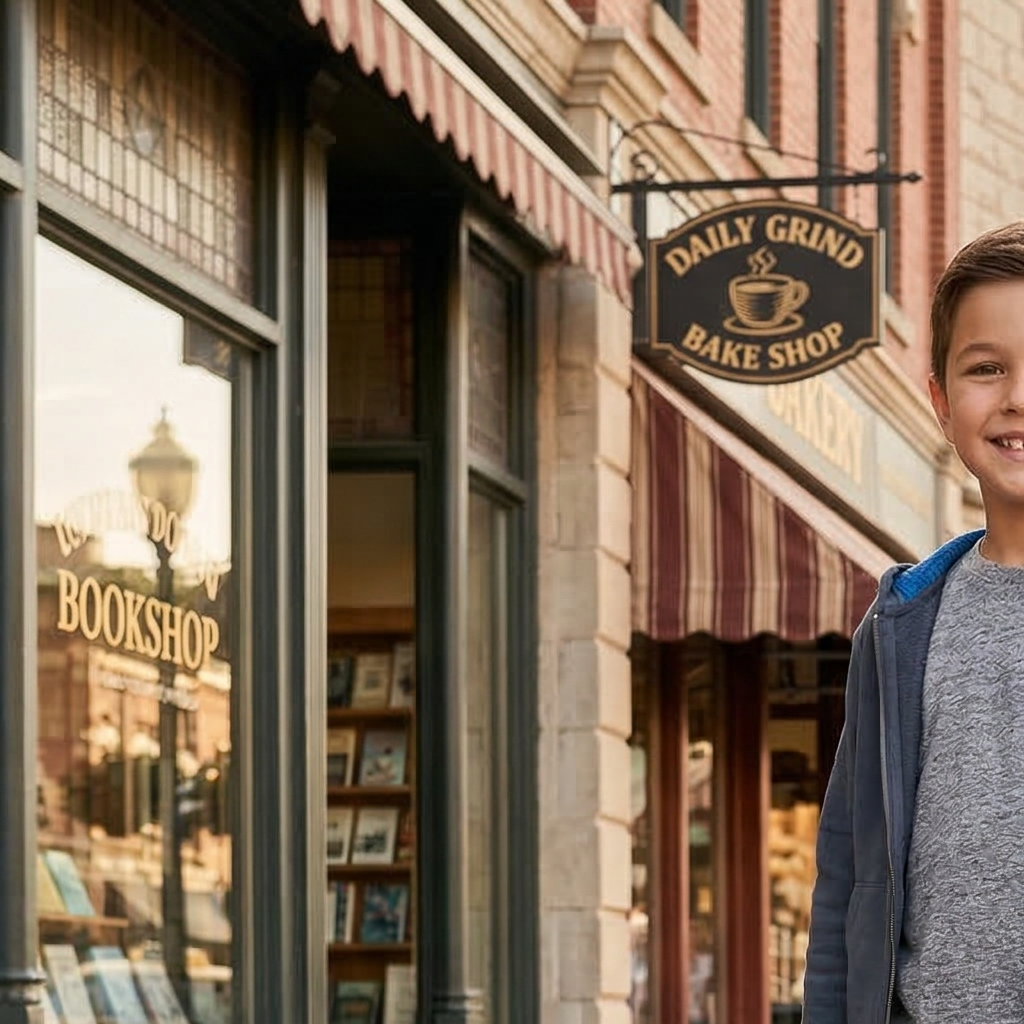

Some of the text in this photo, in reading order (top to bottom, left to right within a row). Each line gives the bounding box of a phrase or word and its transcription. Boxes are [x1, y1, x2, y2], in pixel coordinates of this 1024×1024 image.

[664, 213, 865, 278] DAILY GRIND
[682, 321, 844, 371] BAKE SHOP
[57, 567, 220, 671] BOOKSHOP
